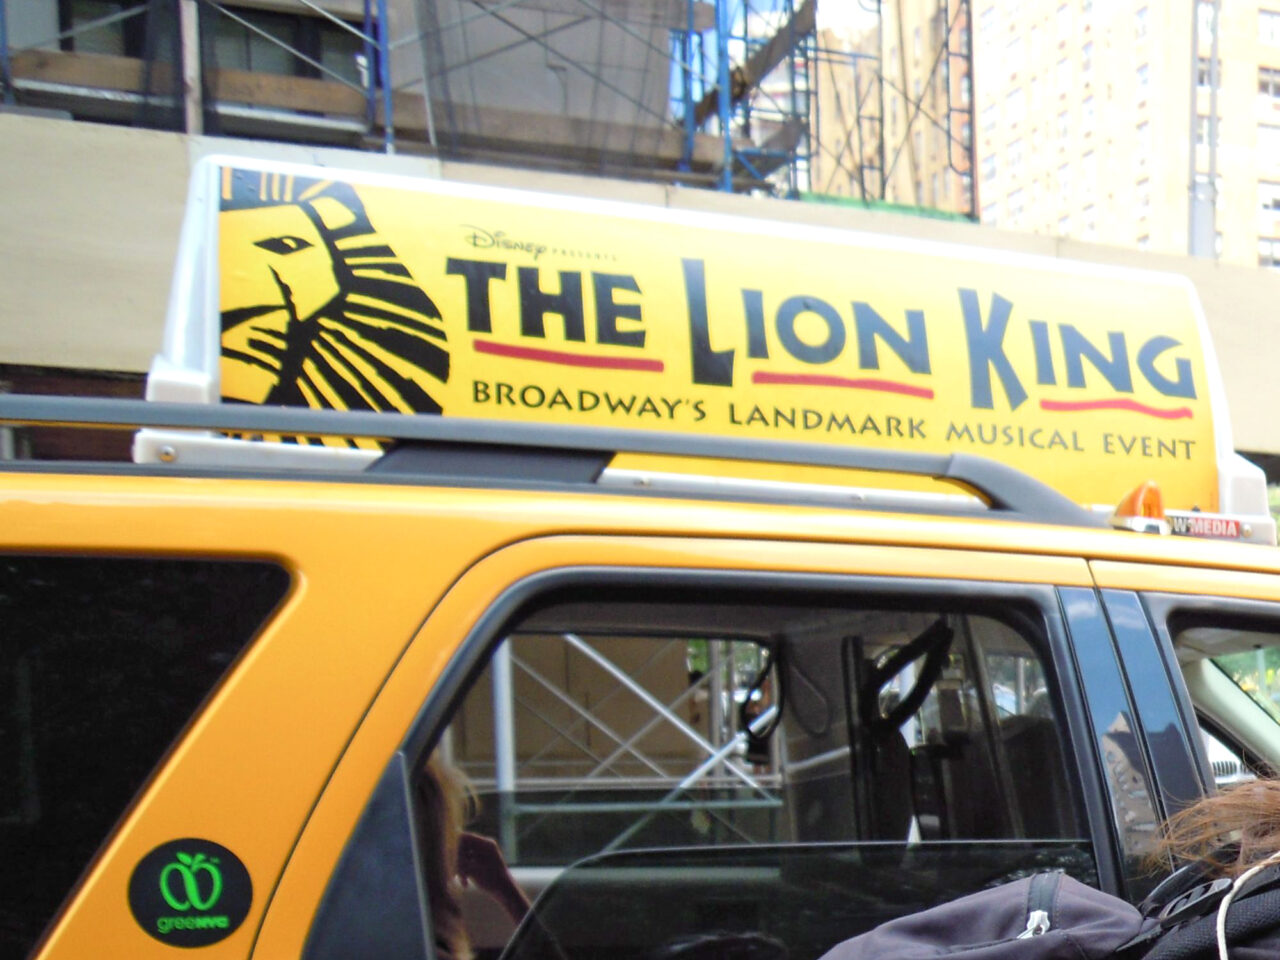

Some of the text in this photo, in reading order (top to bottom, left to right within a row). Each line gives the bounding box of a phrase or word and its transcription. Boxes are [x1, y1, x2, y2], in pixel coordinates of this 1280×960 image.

[446, 257, 1198, 411] THE LION KING
[473, 380, 1196, 459] BROADWAY'S LANDMARK MUSICAL EVENT
[1191, 517, 1238, 538] MEDIA
